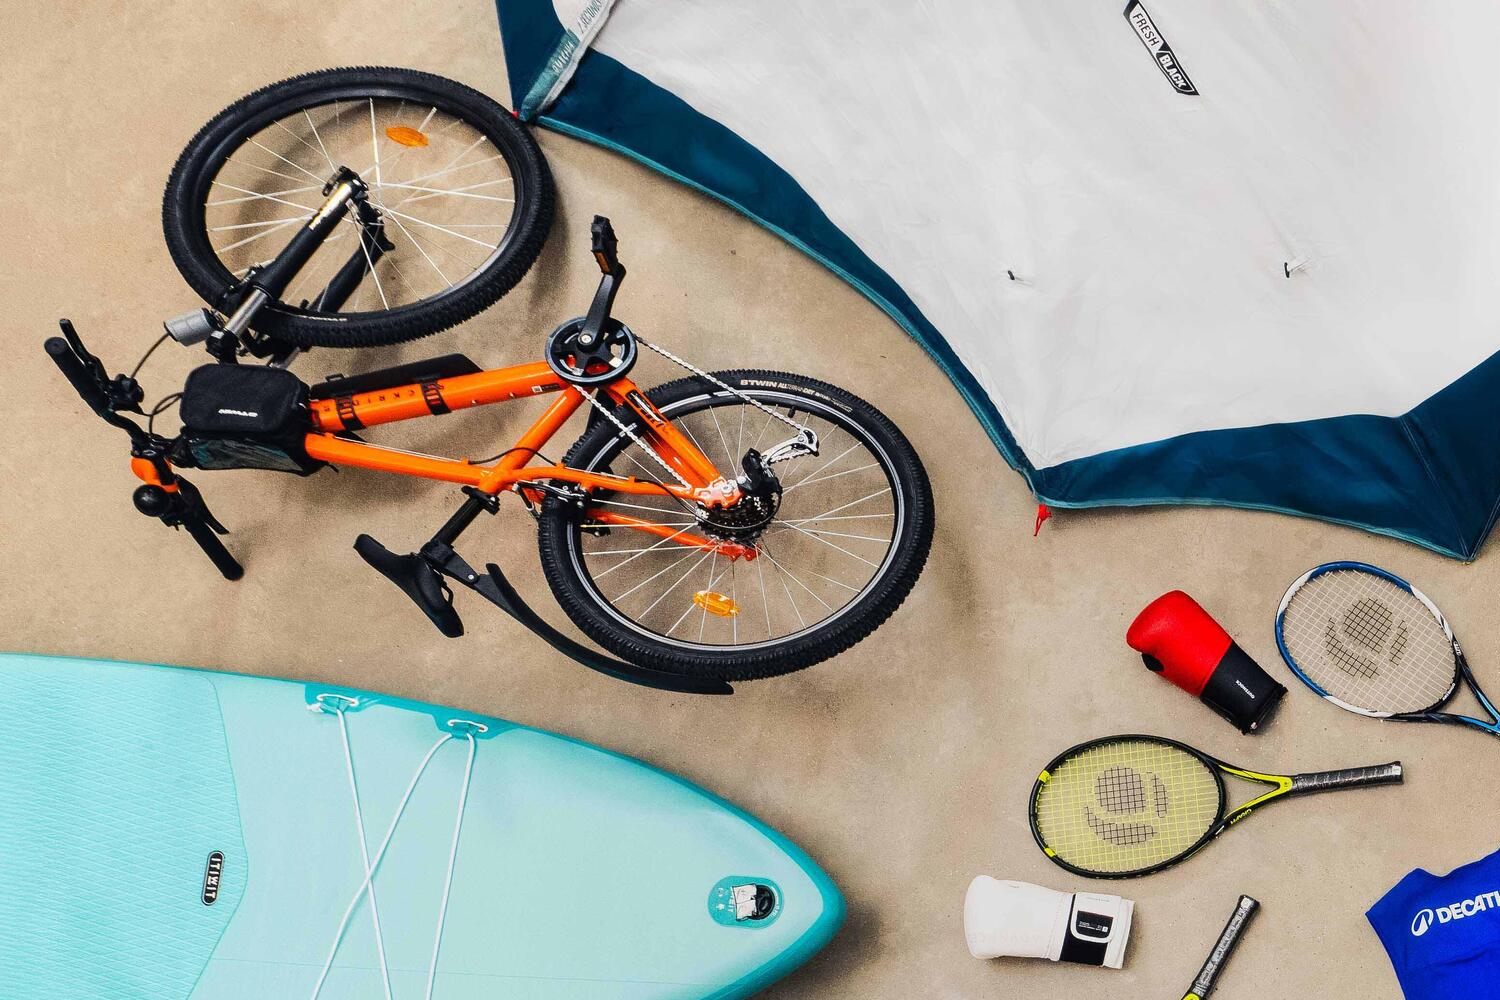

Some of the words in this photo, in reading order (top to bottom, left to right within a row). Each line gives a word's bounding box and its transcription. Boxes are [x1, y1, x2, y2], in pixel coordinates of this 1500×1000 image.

[1132, 12, 1160, 46] FRESH
[1159, 53, 1187, 88] BLACK
[324, 382, 444, 413] RCKRIDR
[740, 379, 778, 389] BTWIN
[204, 857, 222, 899] ITIWIT
